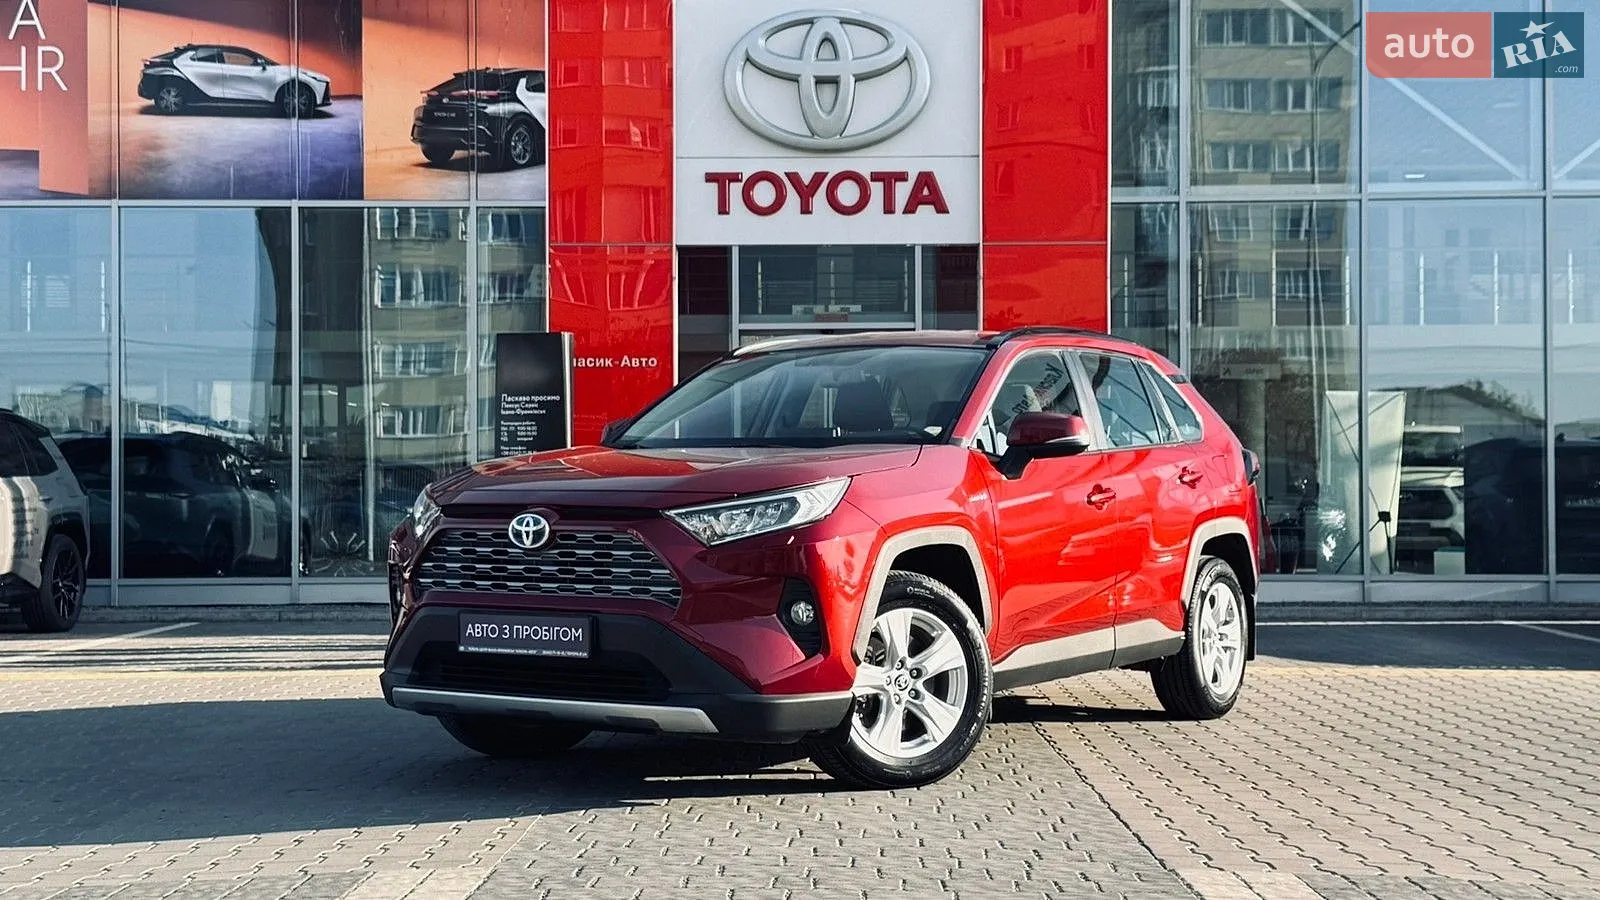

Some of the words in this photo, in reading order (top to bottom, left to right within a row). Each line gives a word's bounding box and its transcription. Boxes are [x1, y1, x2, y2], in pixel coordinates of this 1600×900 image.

[704, 170, 950, 216] TOYOTA
[465, 623, 499, 639] АВТО
[501, 624, 511, 639] З
[513, 625, 584, 642] ПРОБІГОМ
